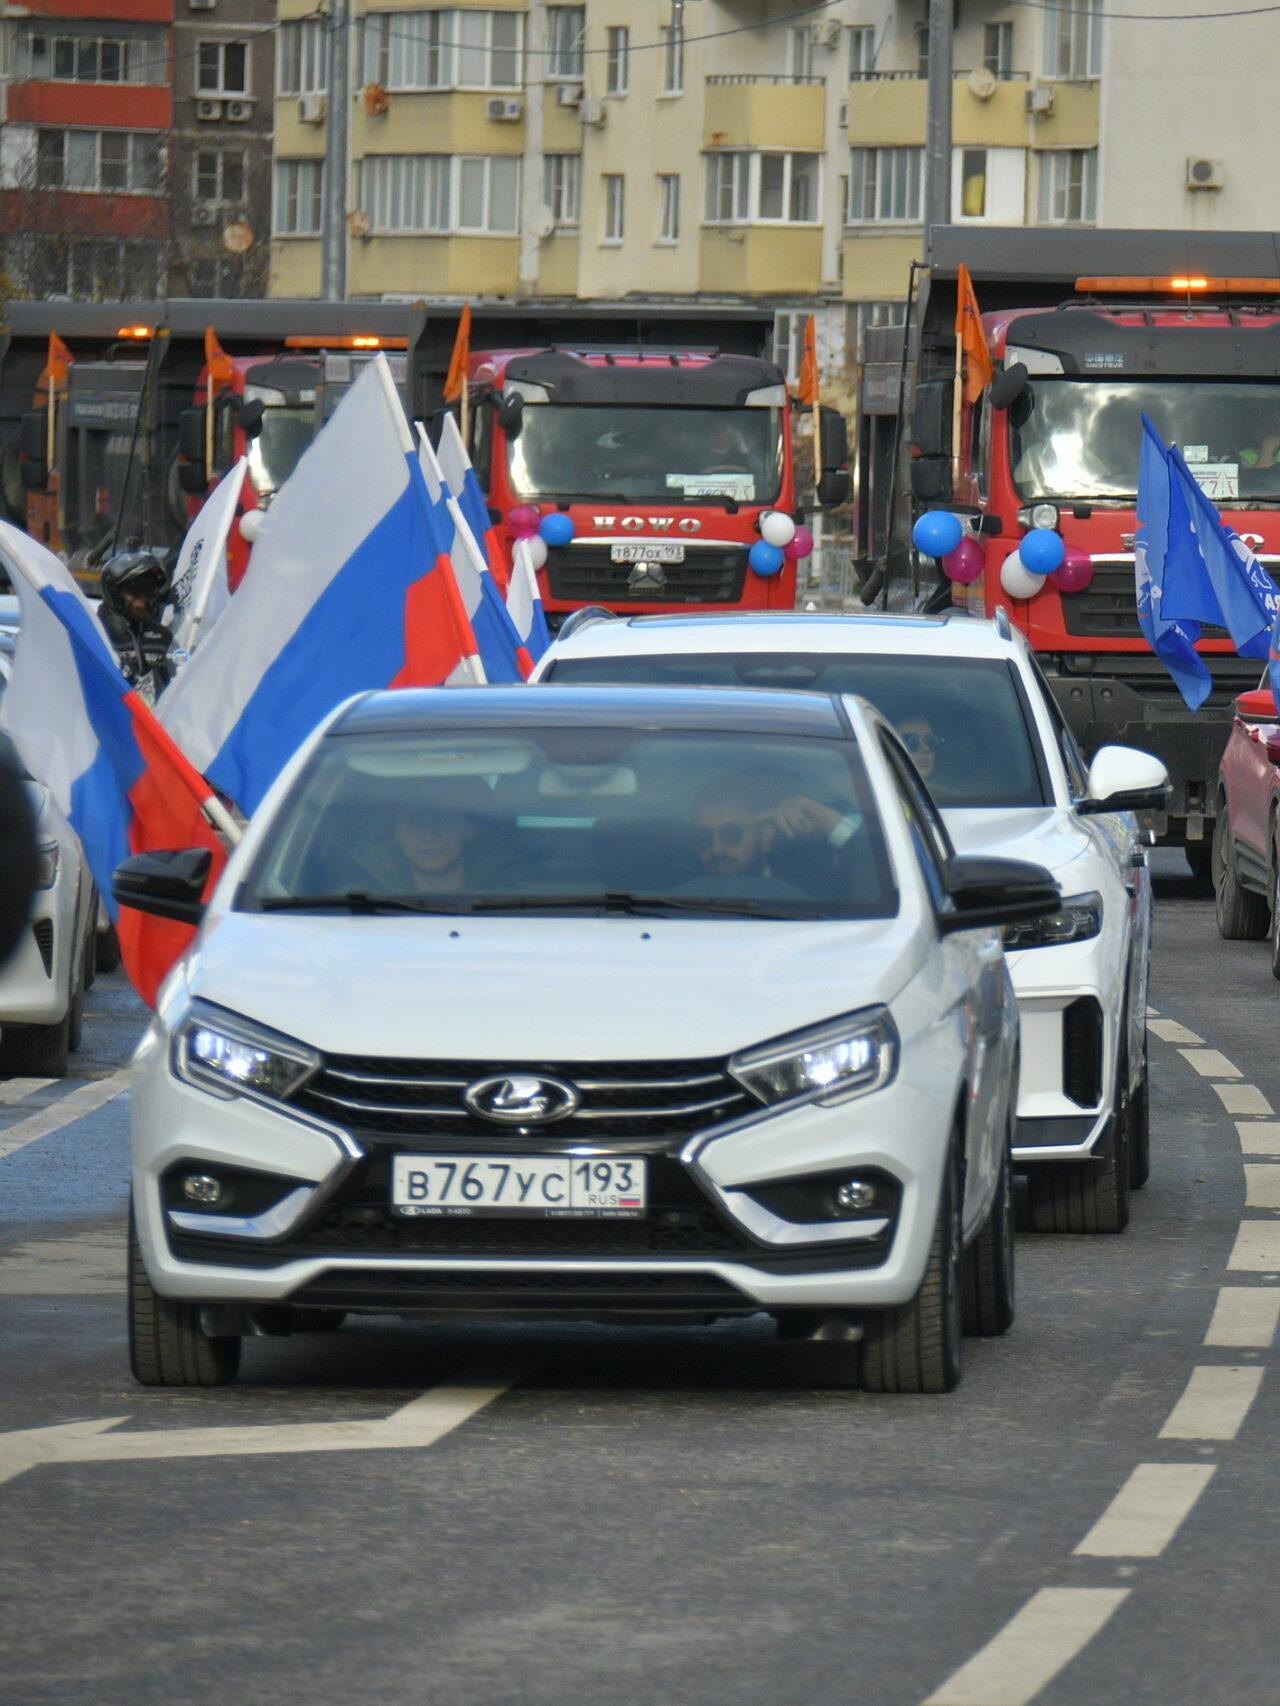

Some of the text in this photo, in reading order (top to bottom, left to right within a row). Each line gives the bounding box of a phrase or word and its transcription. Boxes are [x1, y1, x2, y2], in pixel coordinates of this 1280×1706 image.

[593, 516, 702, 532] HOWO
[407, 1162, 633, 1202] В767УС 193
[589, 1195, 618, 1205] RUS
